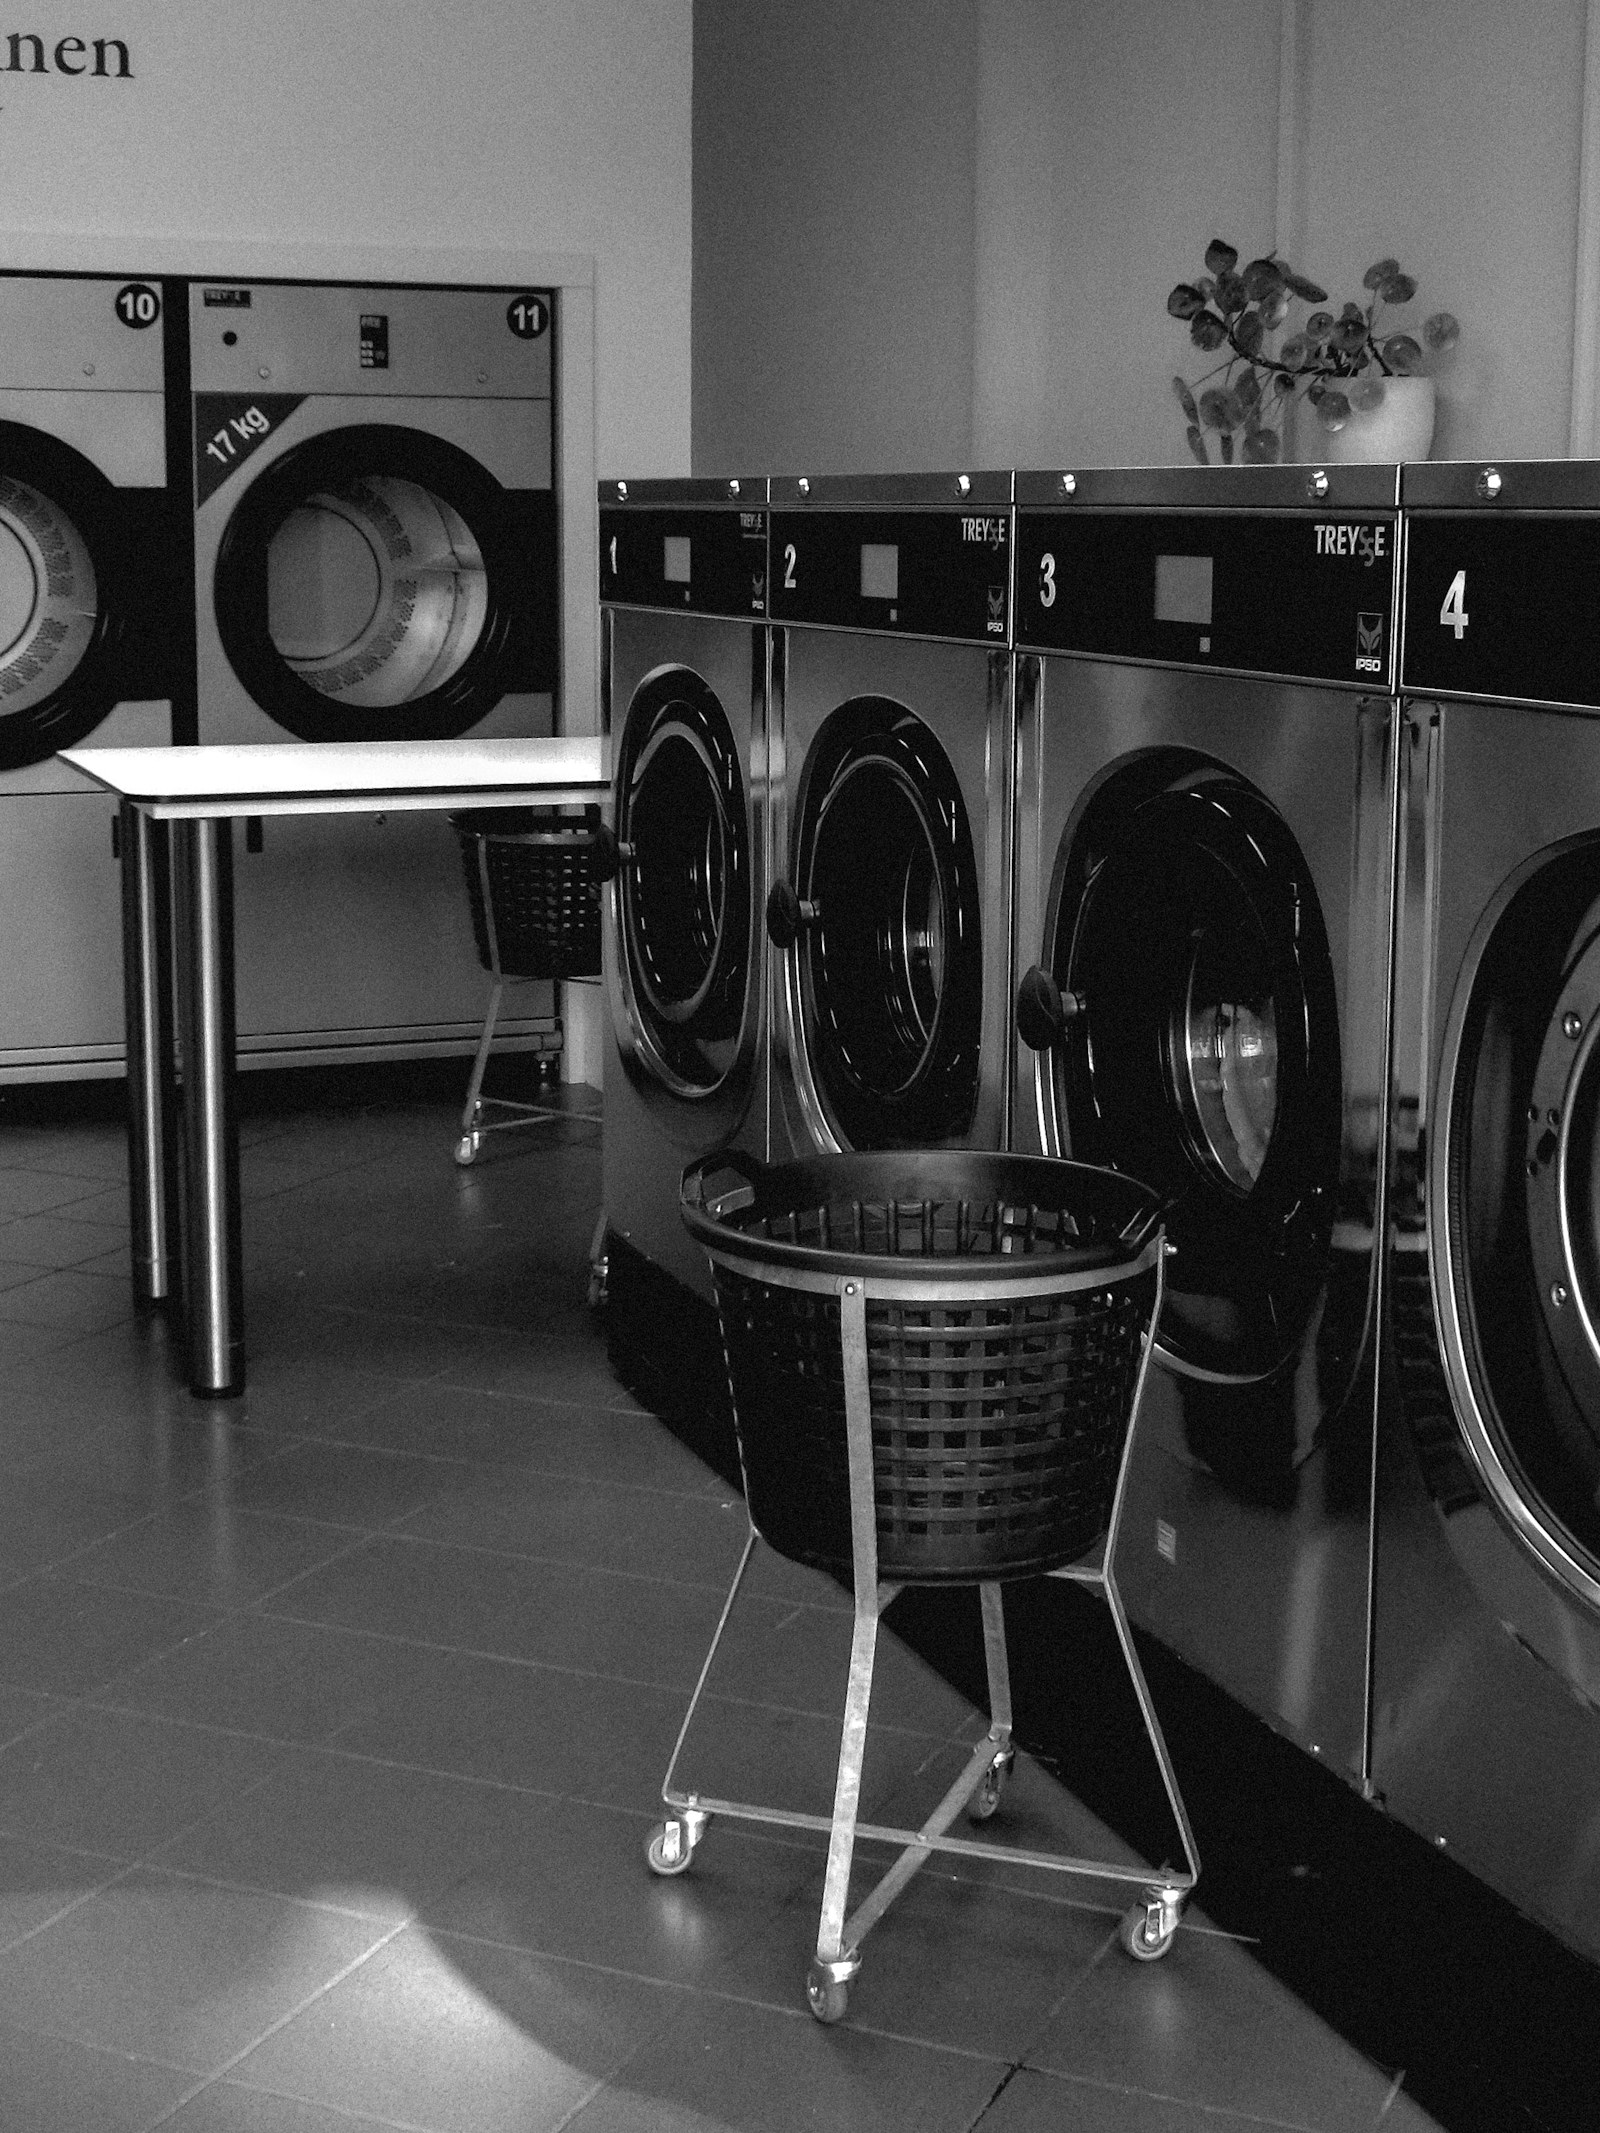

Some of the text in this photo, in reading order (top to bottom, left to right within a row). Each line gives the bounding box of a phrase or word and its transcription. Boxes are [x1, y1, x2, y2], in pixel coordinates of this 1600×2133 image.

[0, 32, 135, 78] nen
[120, 292, 156, 321] 10
[513, 304, 540, 331] 11
[206, 406, 270, 463] 17 kg
[609, 536, 617, 575] 1
[784, 543, 797, 589] 2
[1038, 553, 1056, 608] 3
[1439, 569, 1470, 640] 4
[1355, 658, 1381, 672] IPSO
